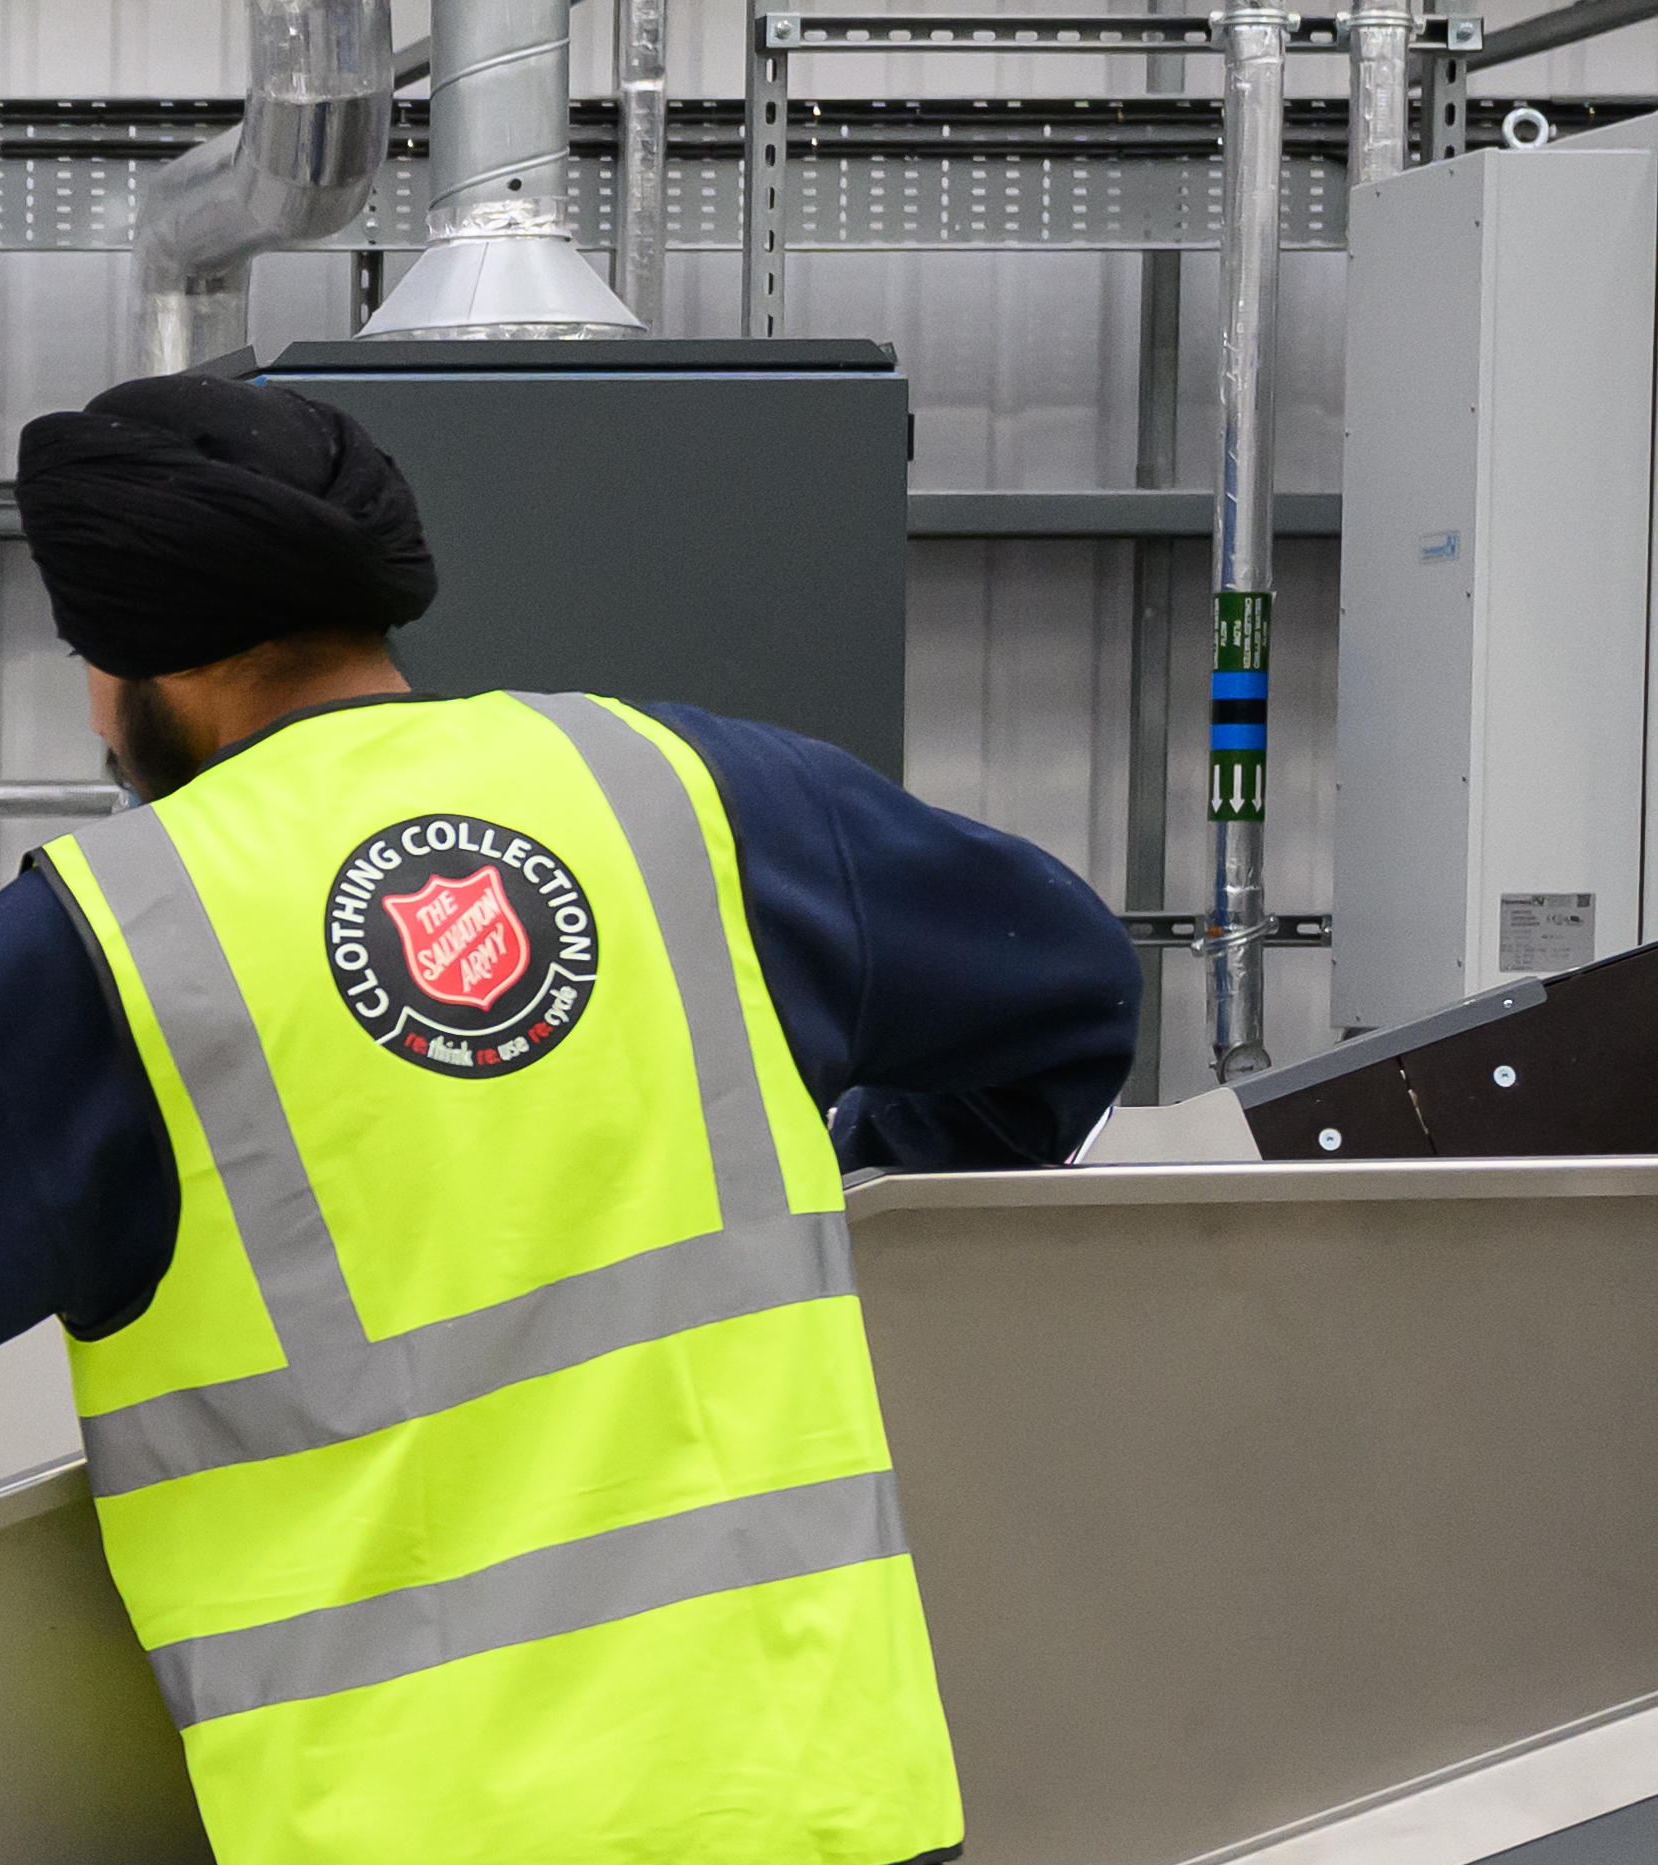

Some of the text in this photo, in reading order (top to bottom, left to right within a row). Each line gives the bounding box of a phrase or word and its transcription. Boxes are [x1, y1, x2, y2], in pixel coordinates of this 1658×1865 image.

[331, 820, 592, 1019] CLOTHING COLLECTION
[416, 889, 458, 934] THE
[417, 887, 501, 981] SALVATION
[459, 922, 509, 994] ARMY
